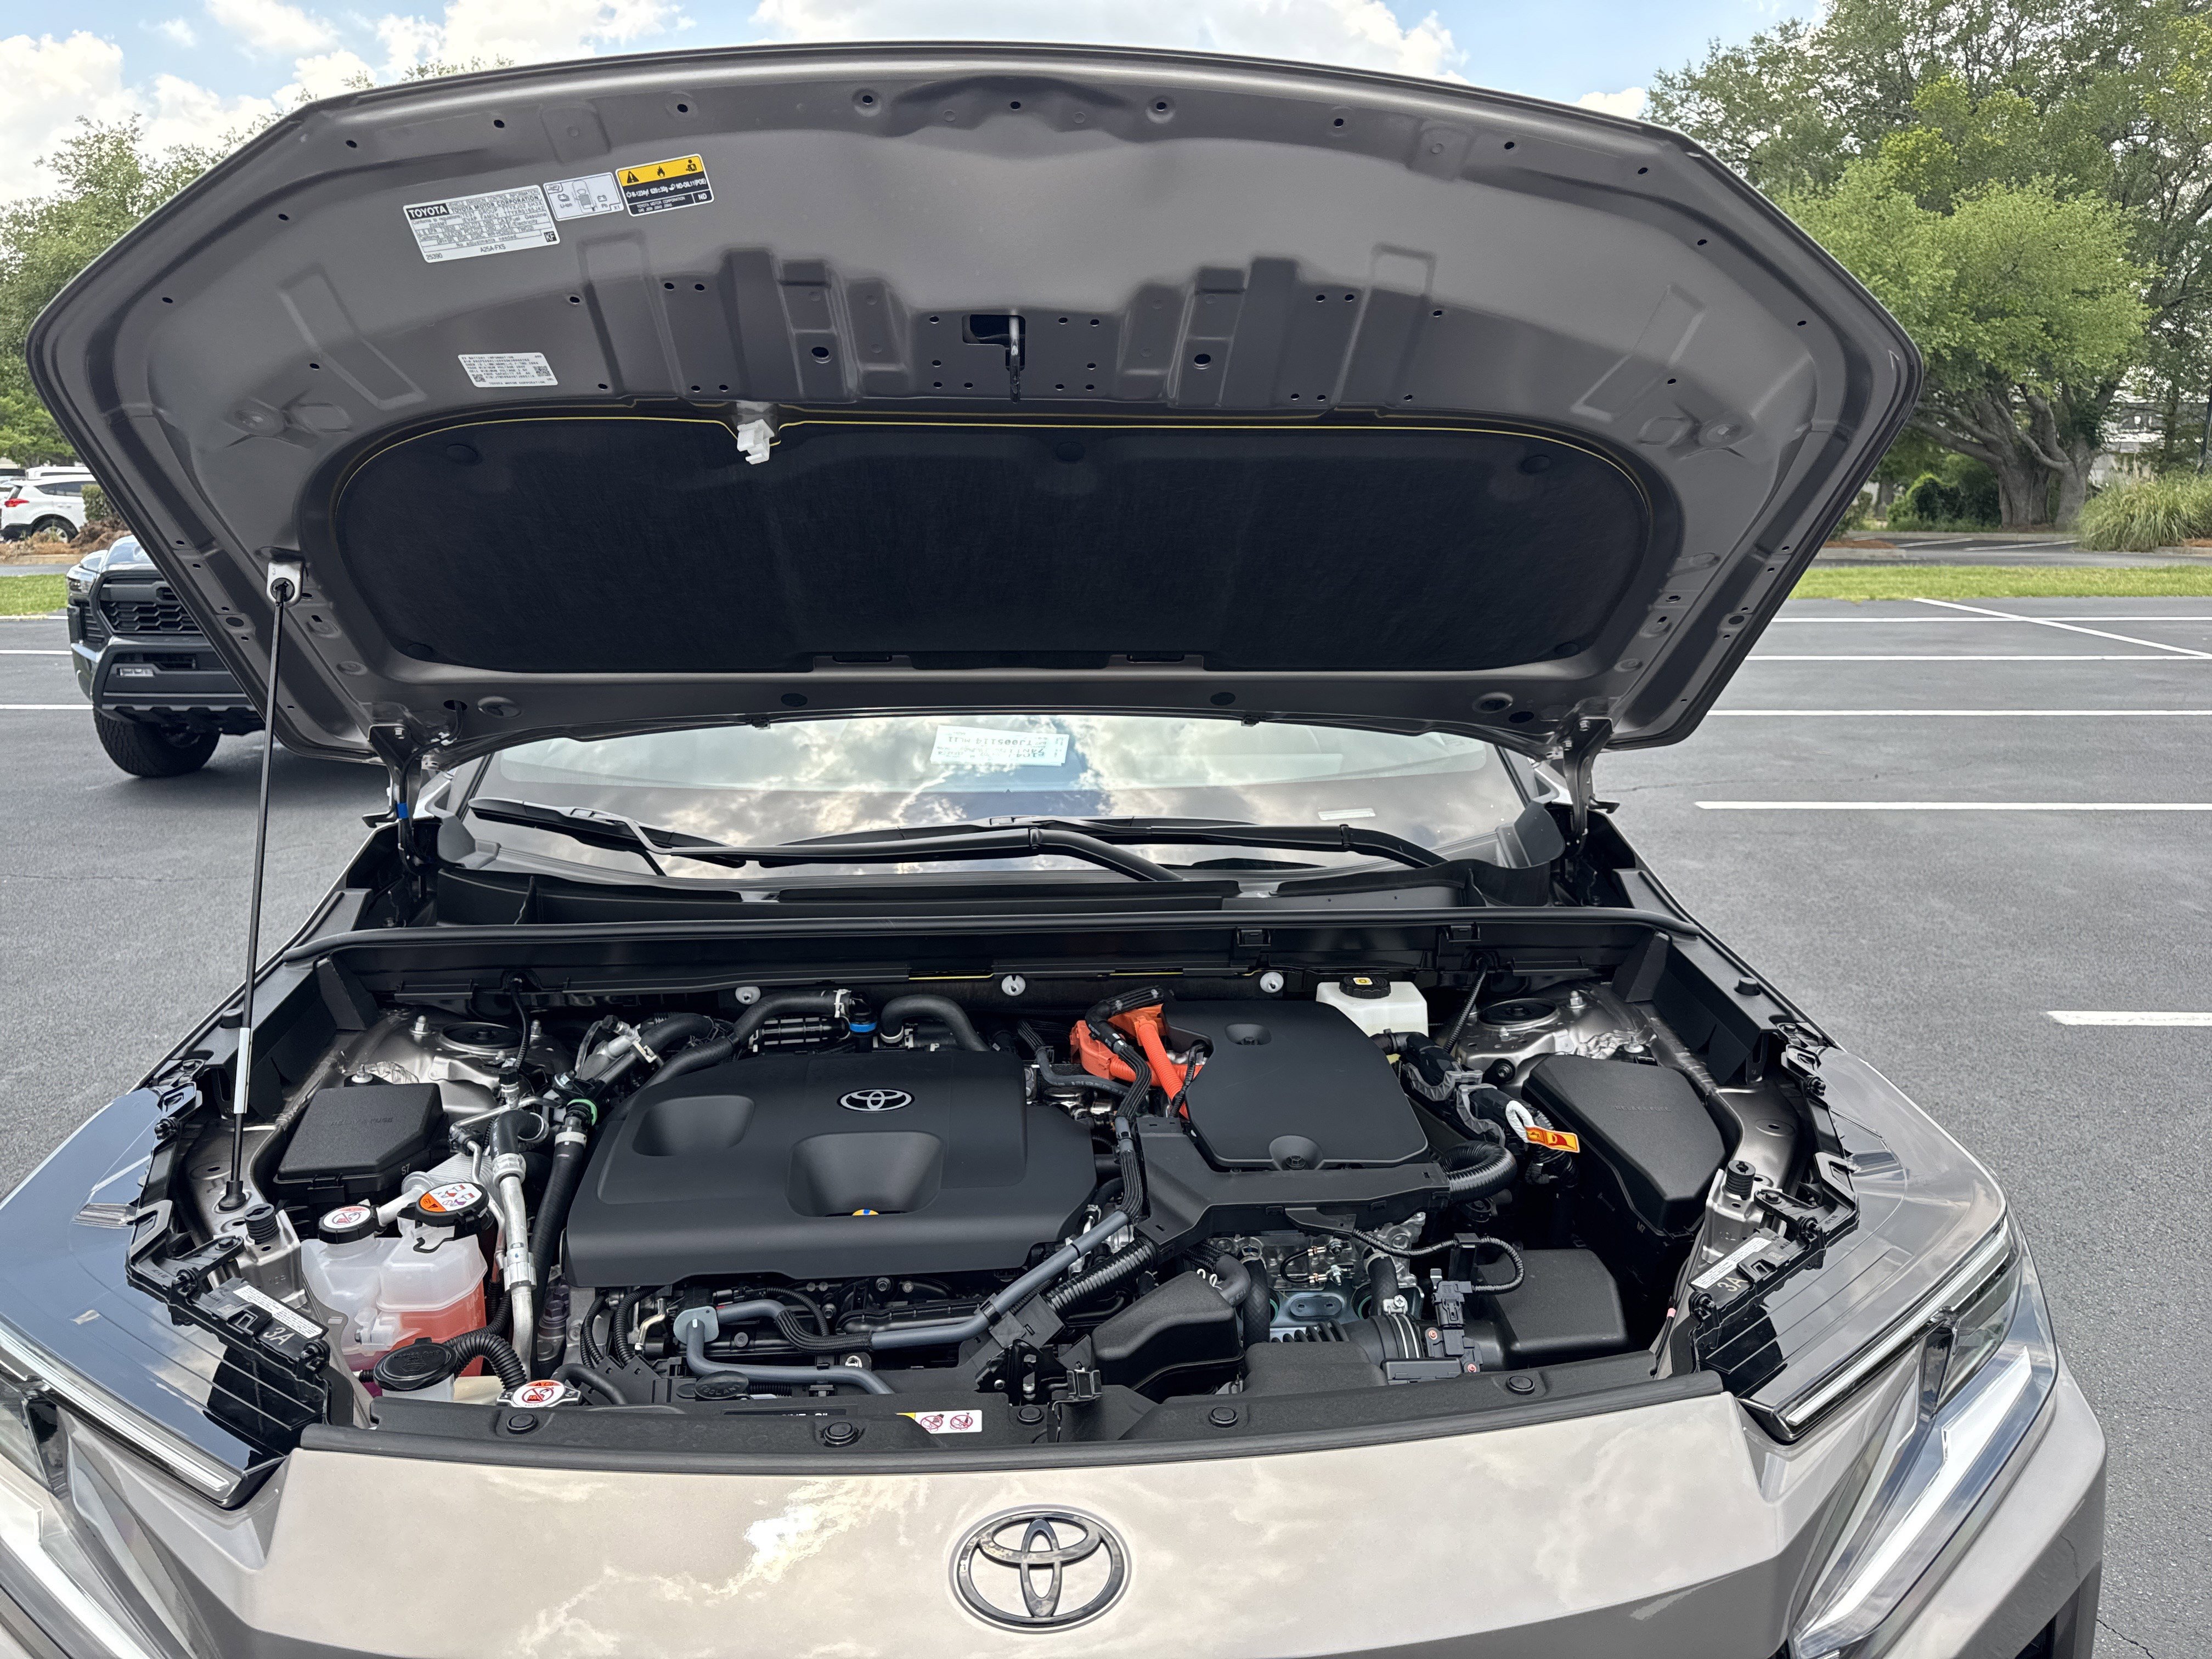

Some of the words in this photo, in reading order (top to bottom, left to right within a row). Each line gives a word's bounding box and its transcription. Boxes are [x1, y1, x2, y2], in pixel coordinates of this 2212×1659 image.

[496, 195, 539, 206] CORPORATION
[408, 205, 448, 218] TOYOTA
[479, 243, 506, 252] A25A-FXS
[401, 1163, 410, 1175] S7
[1717, 1276, 1749, 1292] 3A
[263, 1327, 295, 1346] 3A
[702, 1384, 741, 1395] COOLANT
